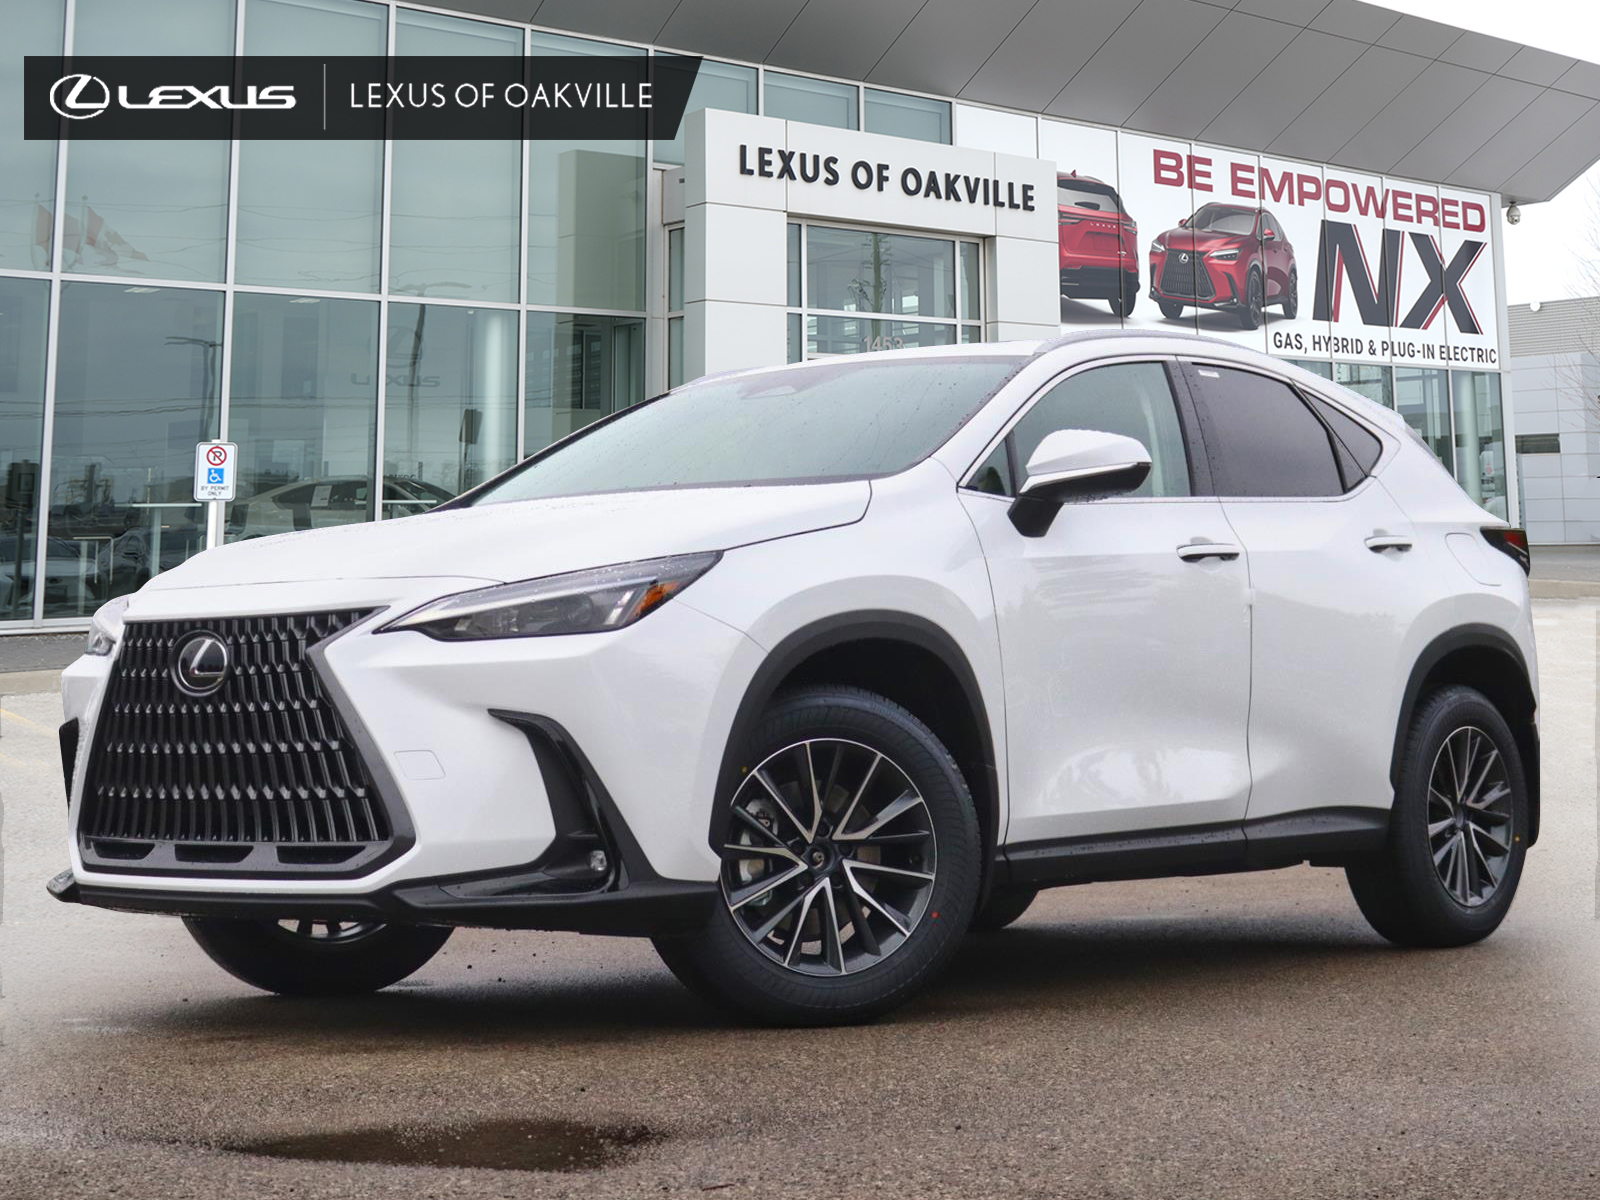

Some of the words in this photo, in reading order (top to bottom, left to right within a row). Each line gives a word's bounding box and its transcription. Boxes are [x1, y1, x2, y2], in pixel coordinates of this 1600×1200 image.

[740, 144, 840, 186] LEXUS
[851, 160, 890, 192] OF
[901, 167, 1036, 212] OAKVILLE
[1153, 149, 1214, 193] BE
[1230, 162, 1486, 233] EMPOWERED
[1312, 219, 1487, 335] NX
[862, 335, 904, 352] 1453
[1273, 331, 1308, 354] GAS,
[1312, 334, 1364, 355] HYBRID
[1368, 339, 1377, 356] &
[1381, 340, 1435, 360] PLUG-IN
[1439, 344, 1497, 364] ELECTRIC
